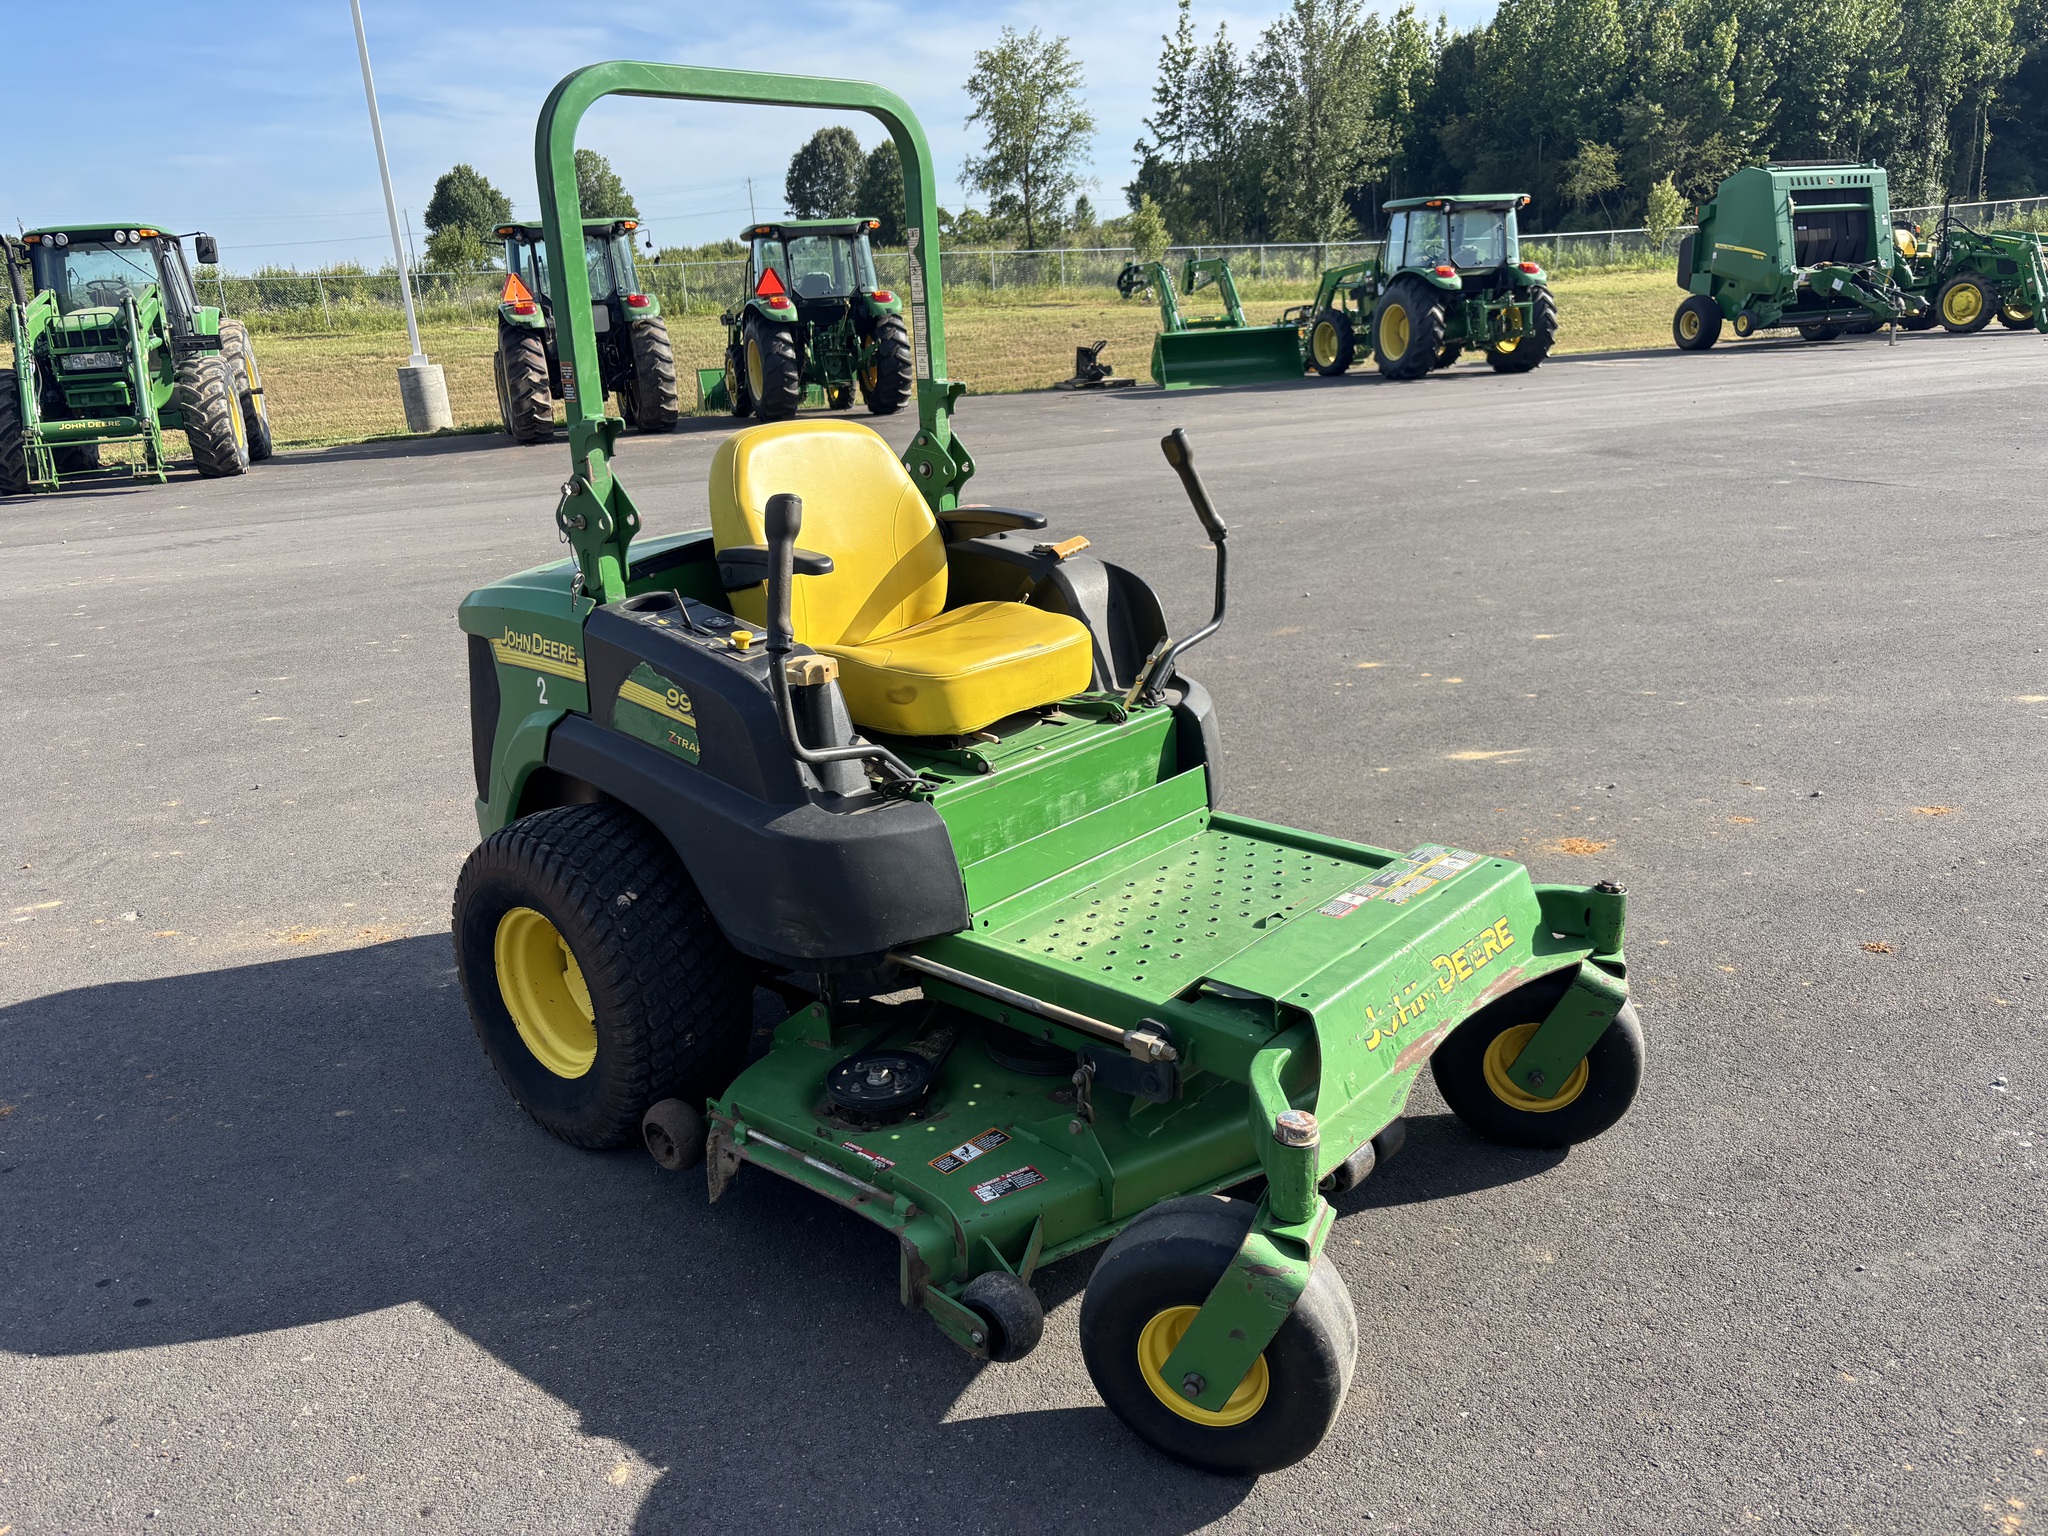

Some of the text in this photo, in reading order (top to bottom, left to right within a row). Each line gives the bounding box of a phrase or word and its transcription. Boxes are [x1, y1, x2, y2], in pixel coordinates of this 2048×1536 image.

[58, 422, 86, 430] JOHN
[501, 625, 577, 664] JOHN DEERE
[536, 676, 549, 705] 2
[1430, 914, 1516, 996] DEERE
